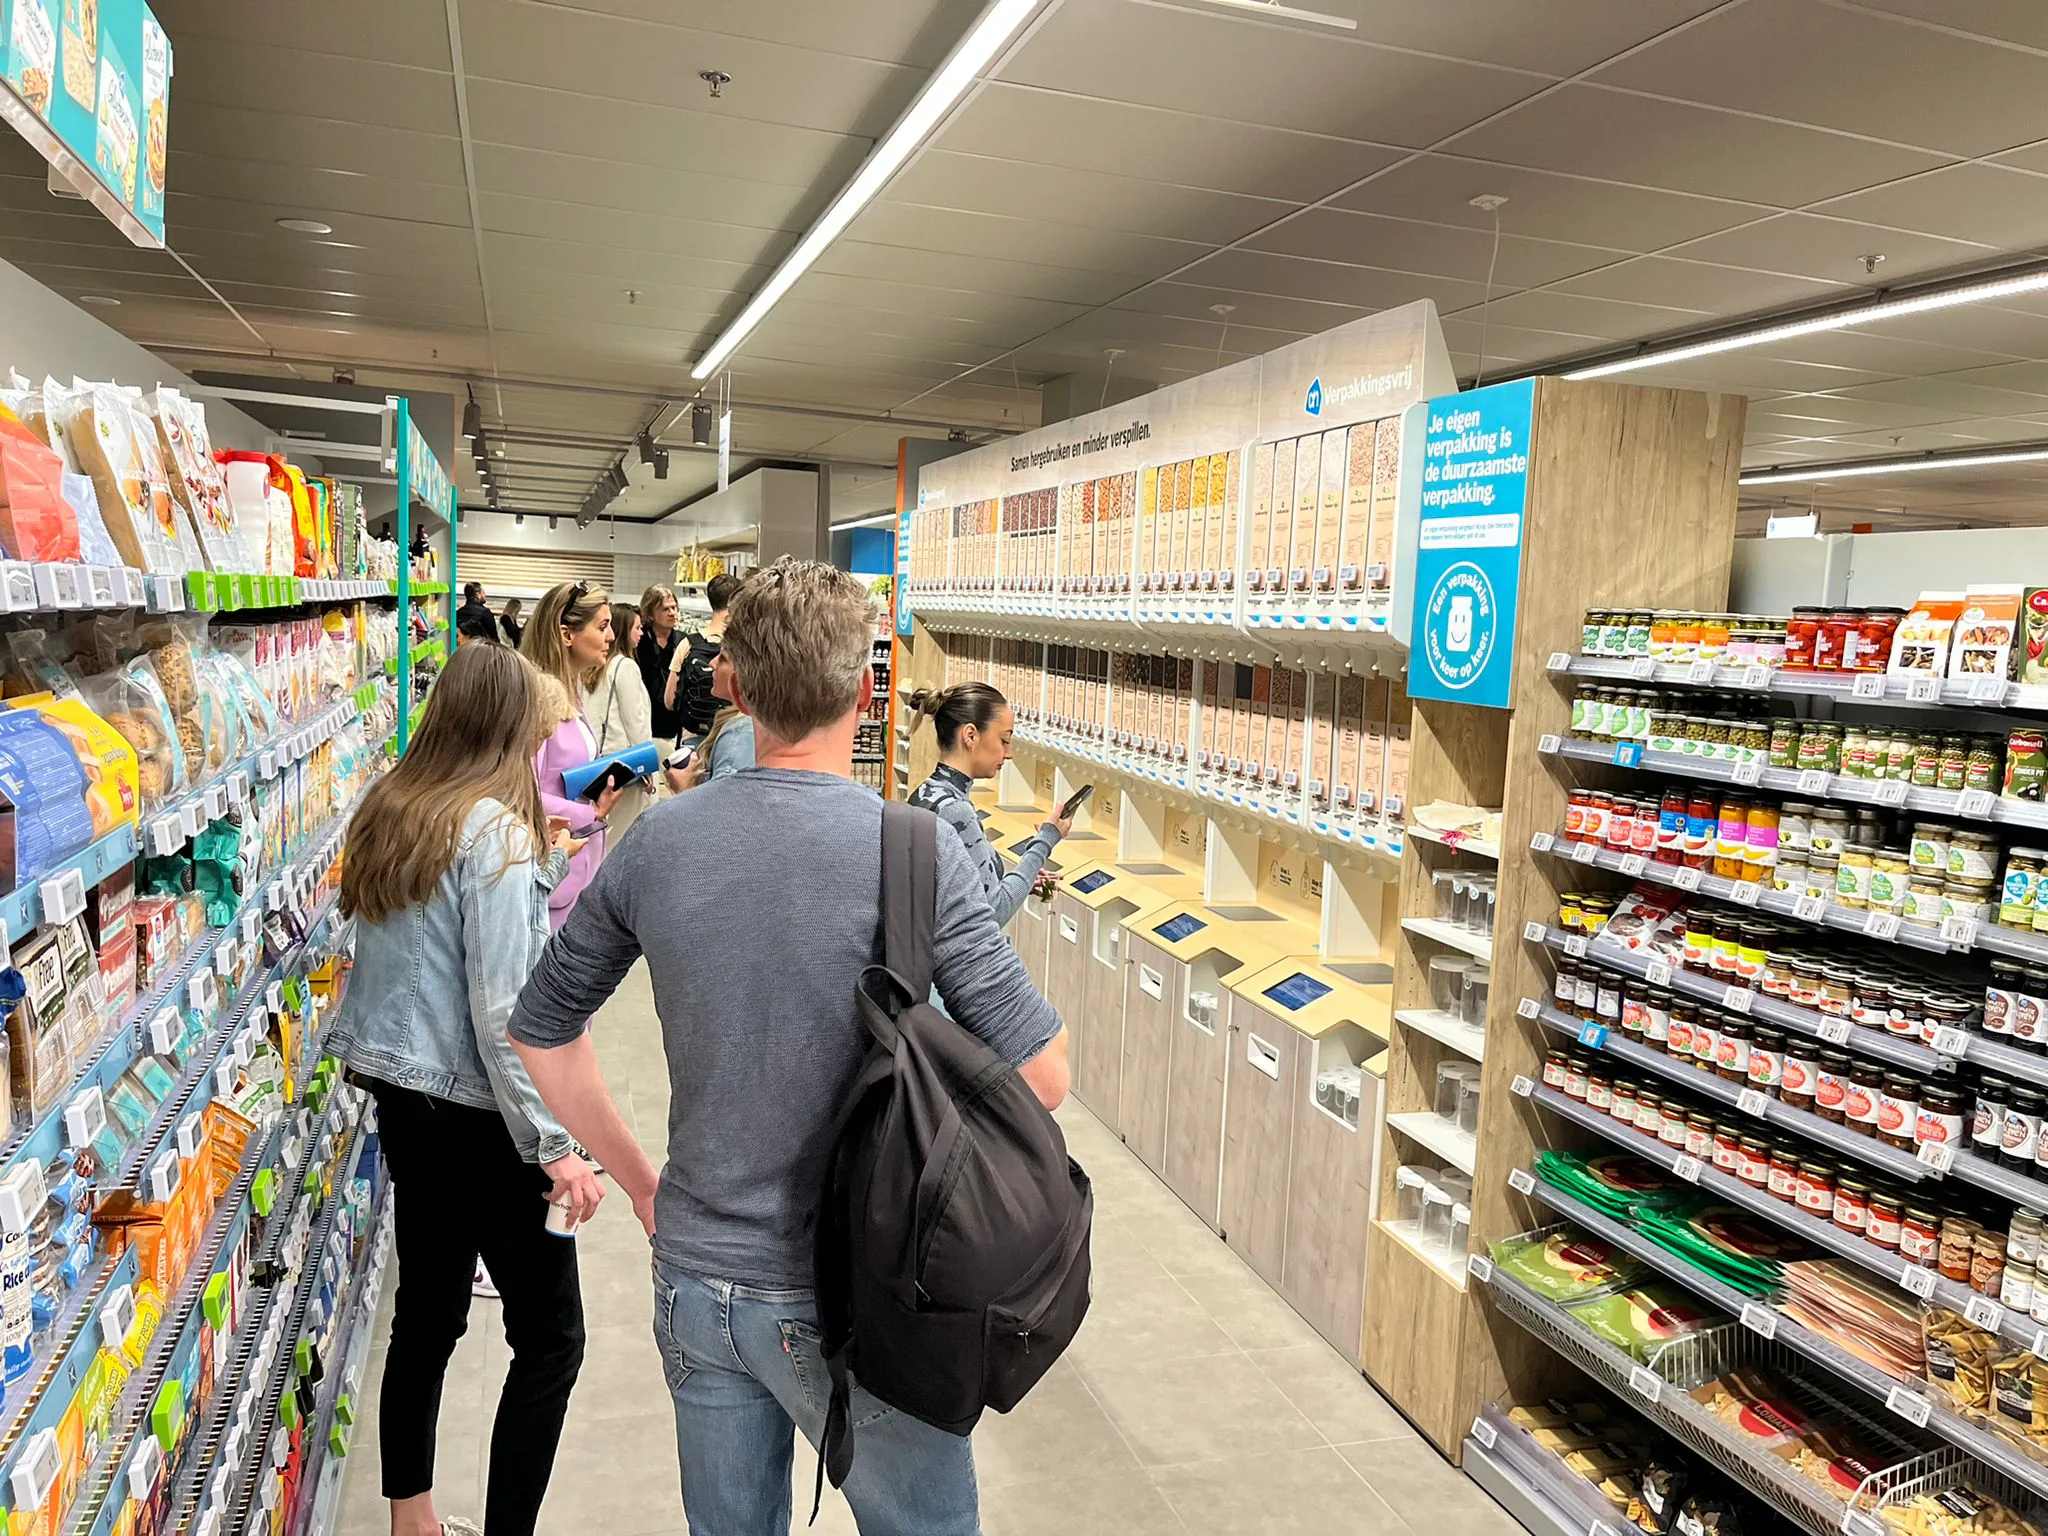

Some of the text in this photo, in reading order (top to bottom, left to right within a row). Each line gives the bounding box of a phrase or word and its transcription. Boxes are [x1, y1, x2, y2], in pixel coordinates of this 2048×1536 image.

[1324, 364, 1412, 405] Verpakkingsvrij
[1428, 409, 1480, 434] Je eigen
[1011, 421, 1151, 472] Samen hergebruiken en minder verspillen.
[1427, 426, 1512, 459] verpakking is
[1425, 453, 1526, 482] de duurzaamste
[1423, 481, 1496, 509] verpakking.
[1432, 573, 1490, 617] Een verpakking
[1430, 628, 1489, 678] voor keer op keer.
[2036, 768, 2045, 777] PIT
[3, 1272, 24, 1292] Rice
